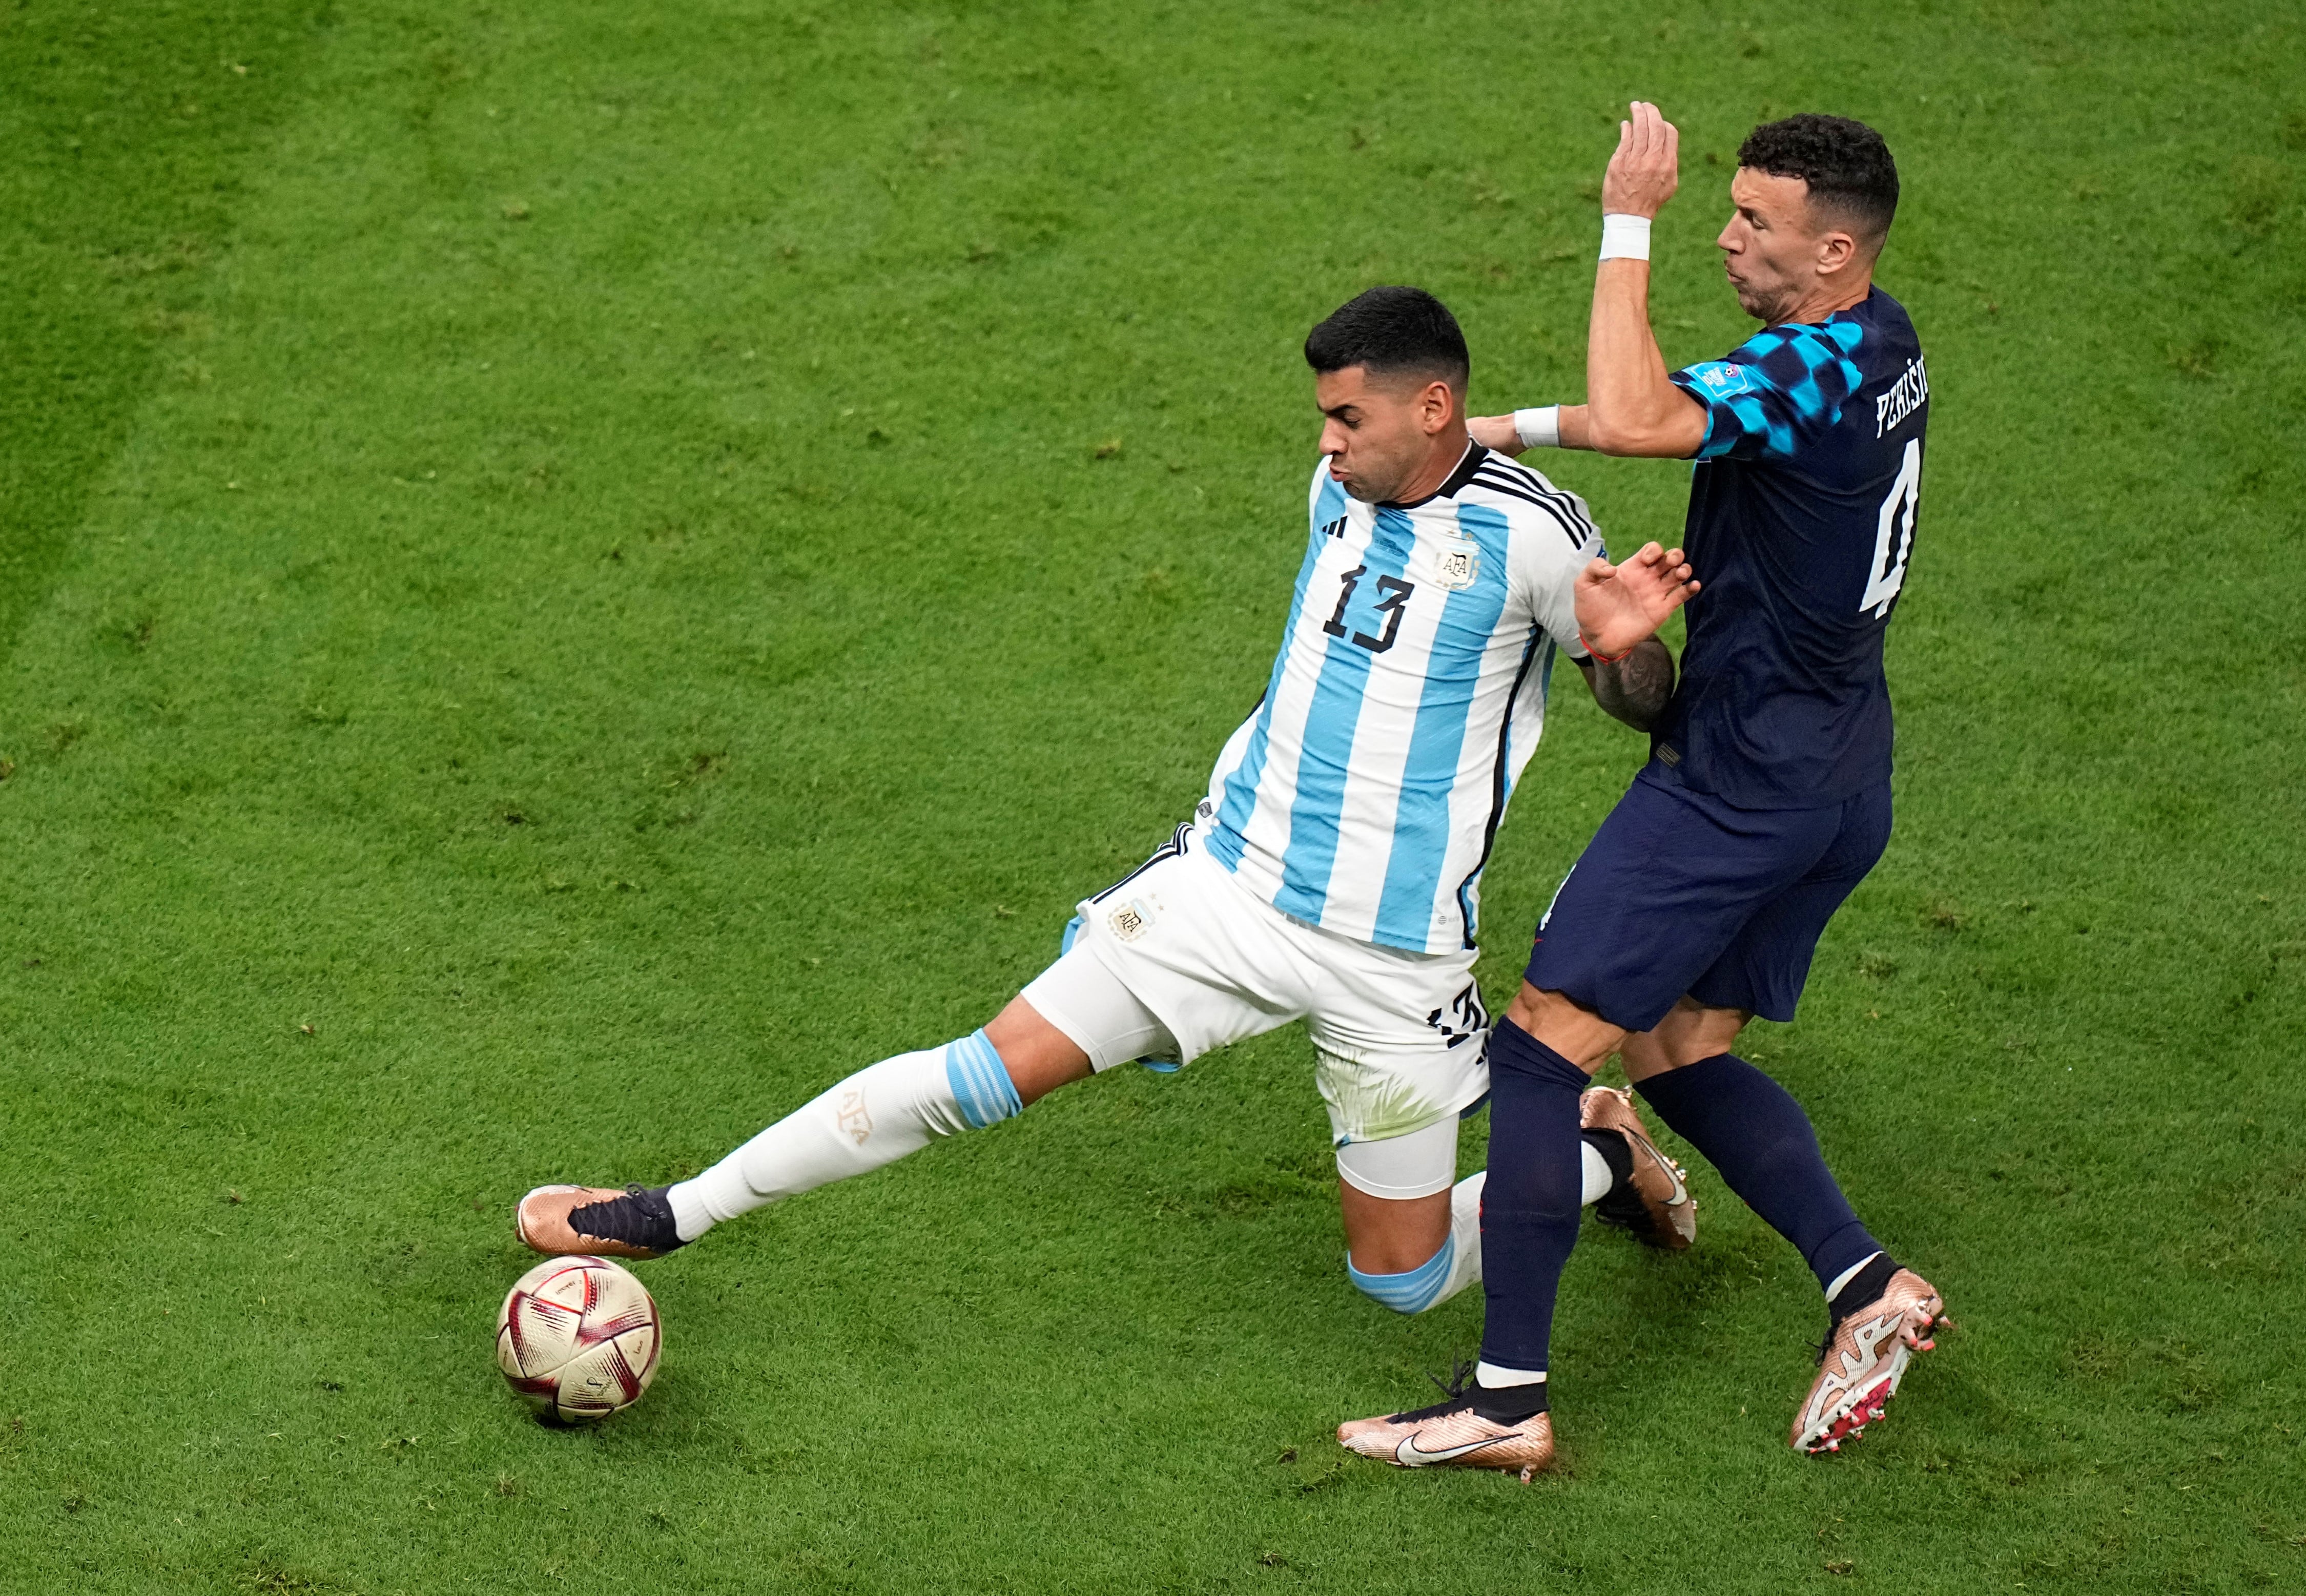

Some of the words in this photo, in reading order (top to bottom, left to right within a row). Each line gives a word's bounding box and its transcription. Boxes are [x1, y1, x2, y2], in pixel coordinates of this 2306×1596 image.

[1859, 438, 1921, 620] 4
[1443, 552, 1467, 577] AFA
[1323, 565, 1415, 654] 13
[1119, 909, 1142, 932] AFA
[836, 1086, 873, 1146] AFA
